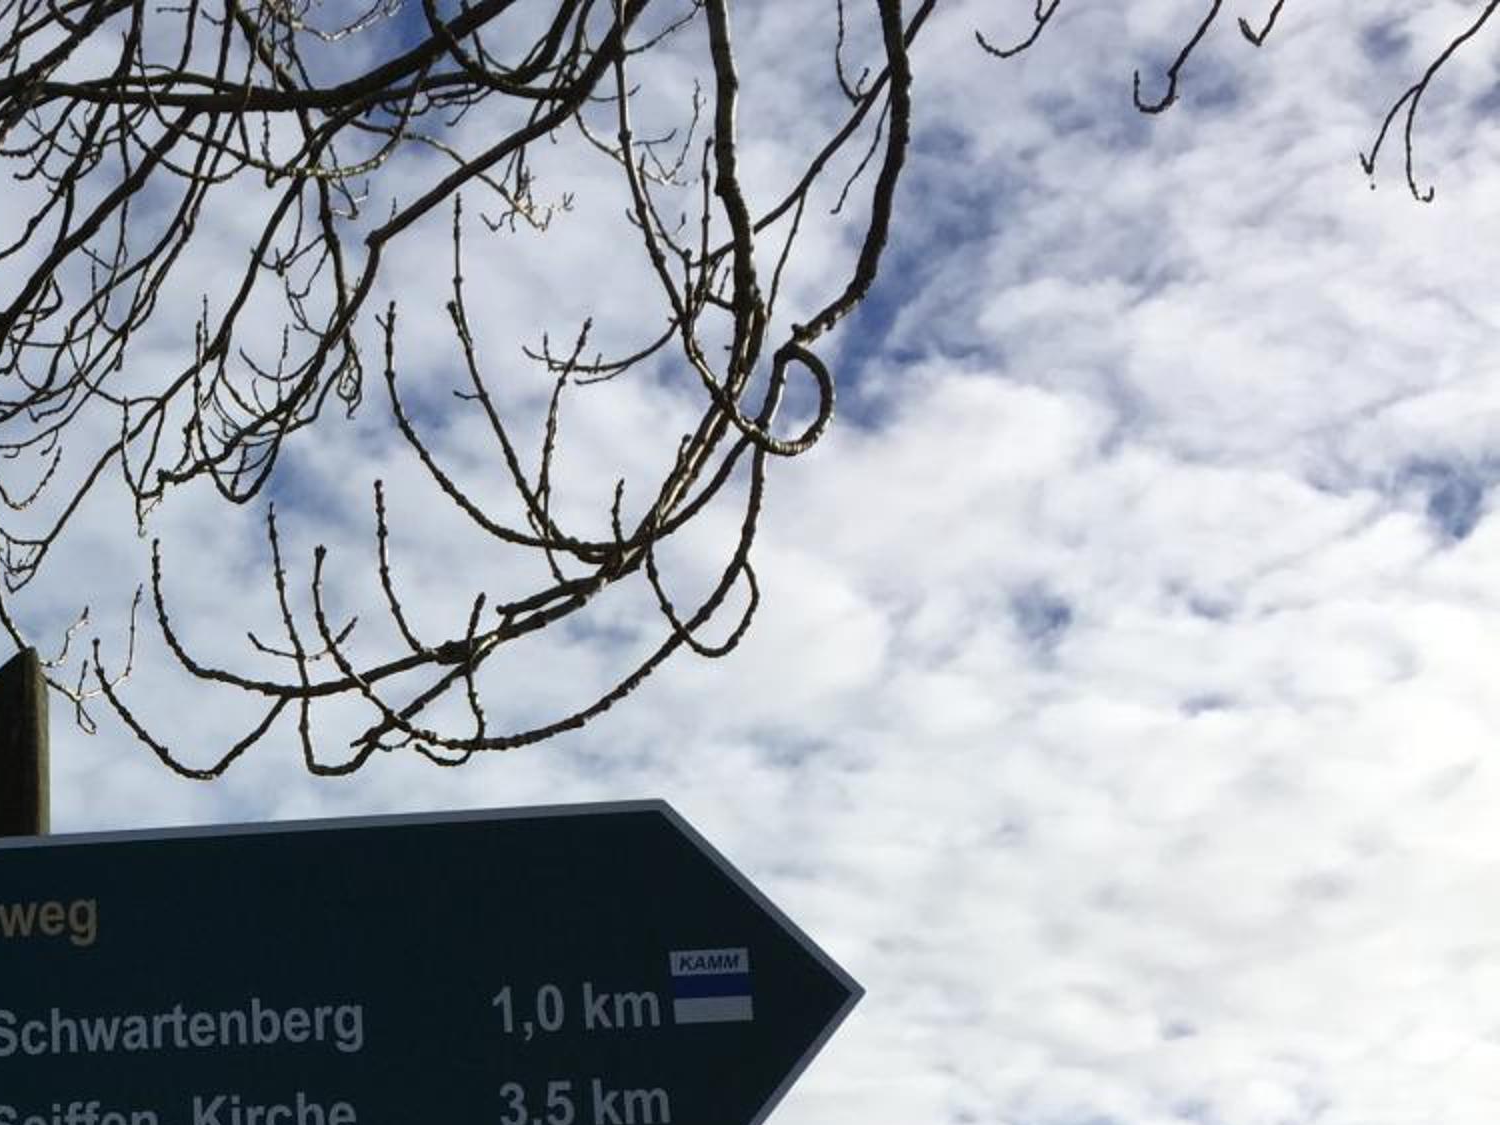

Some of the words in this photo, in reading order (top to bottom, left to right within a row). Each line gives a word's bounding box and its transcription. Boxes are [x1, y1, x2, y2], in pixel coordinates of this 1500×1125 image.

[680, 954, 739, 971] KAMM
[491, 985, 565, 1041] 1,0
[583, 982, 661, 1029] km
[592, 1079, 671, 1125] km
